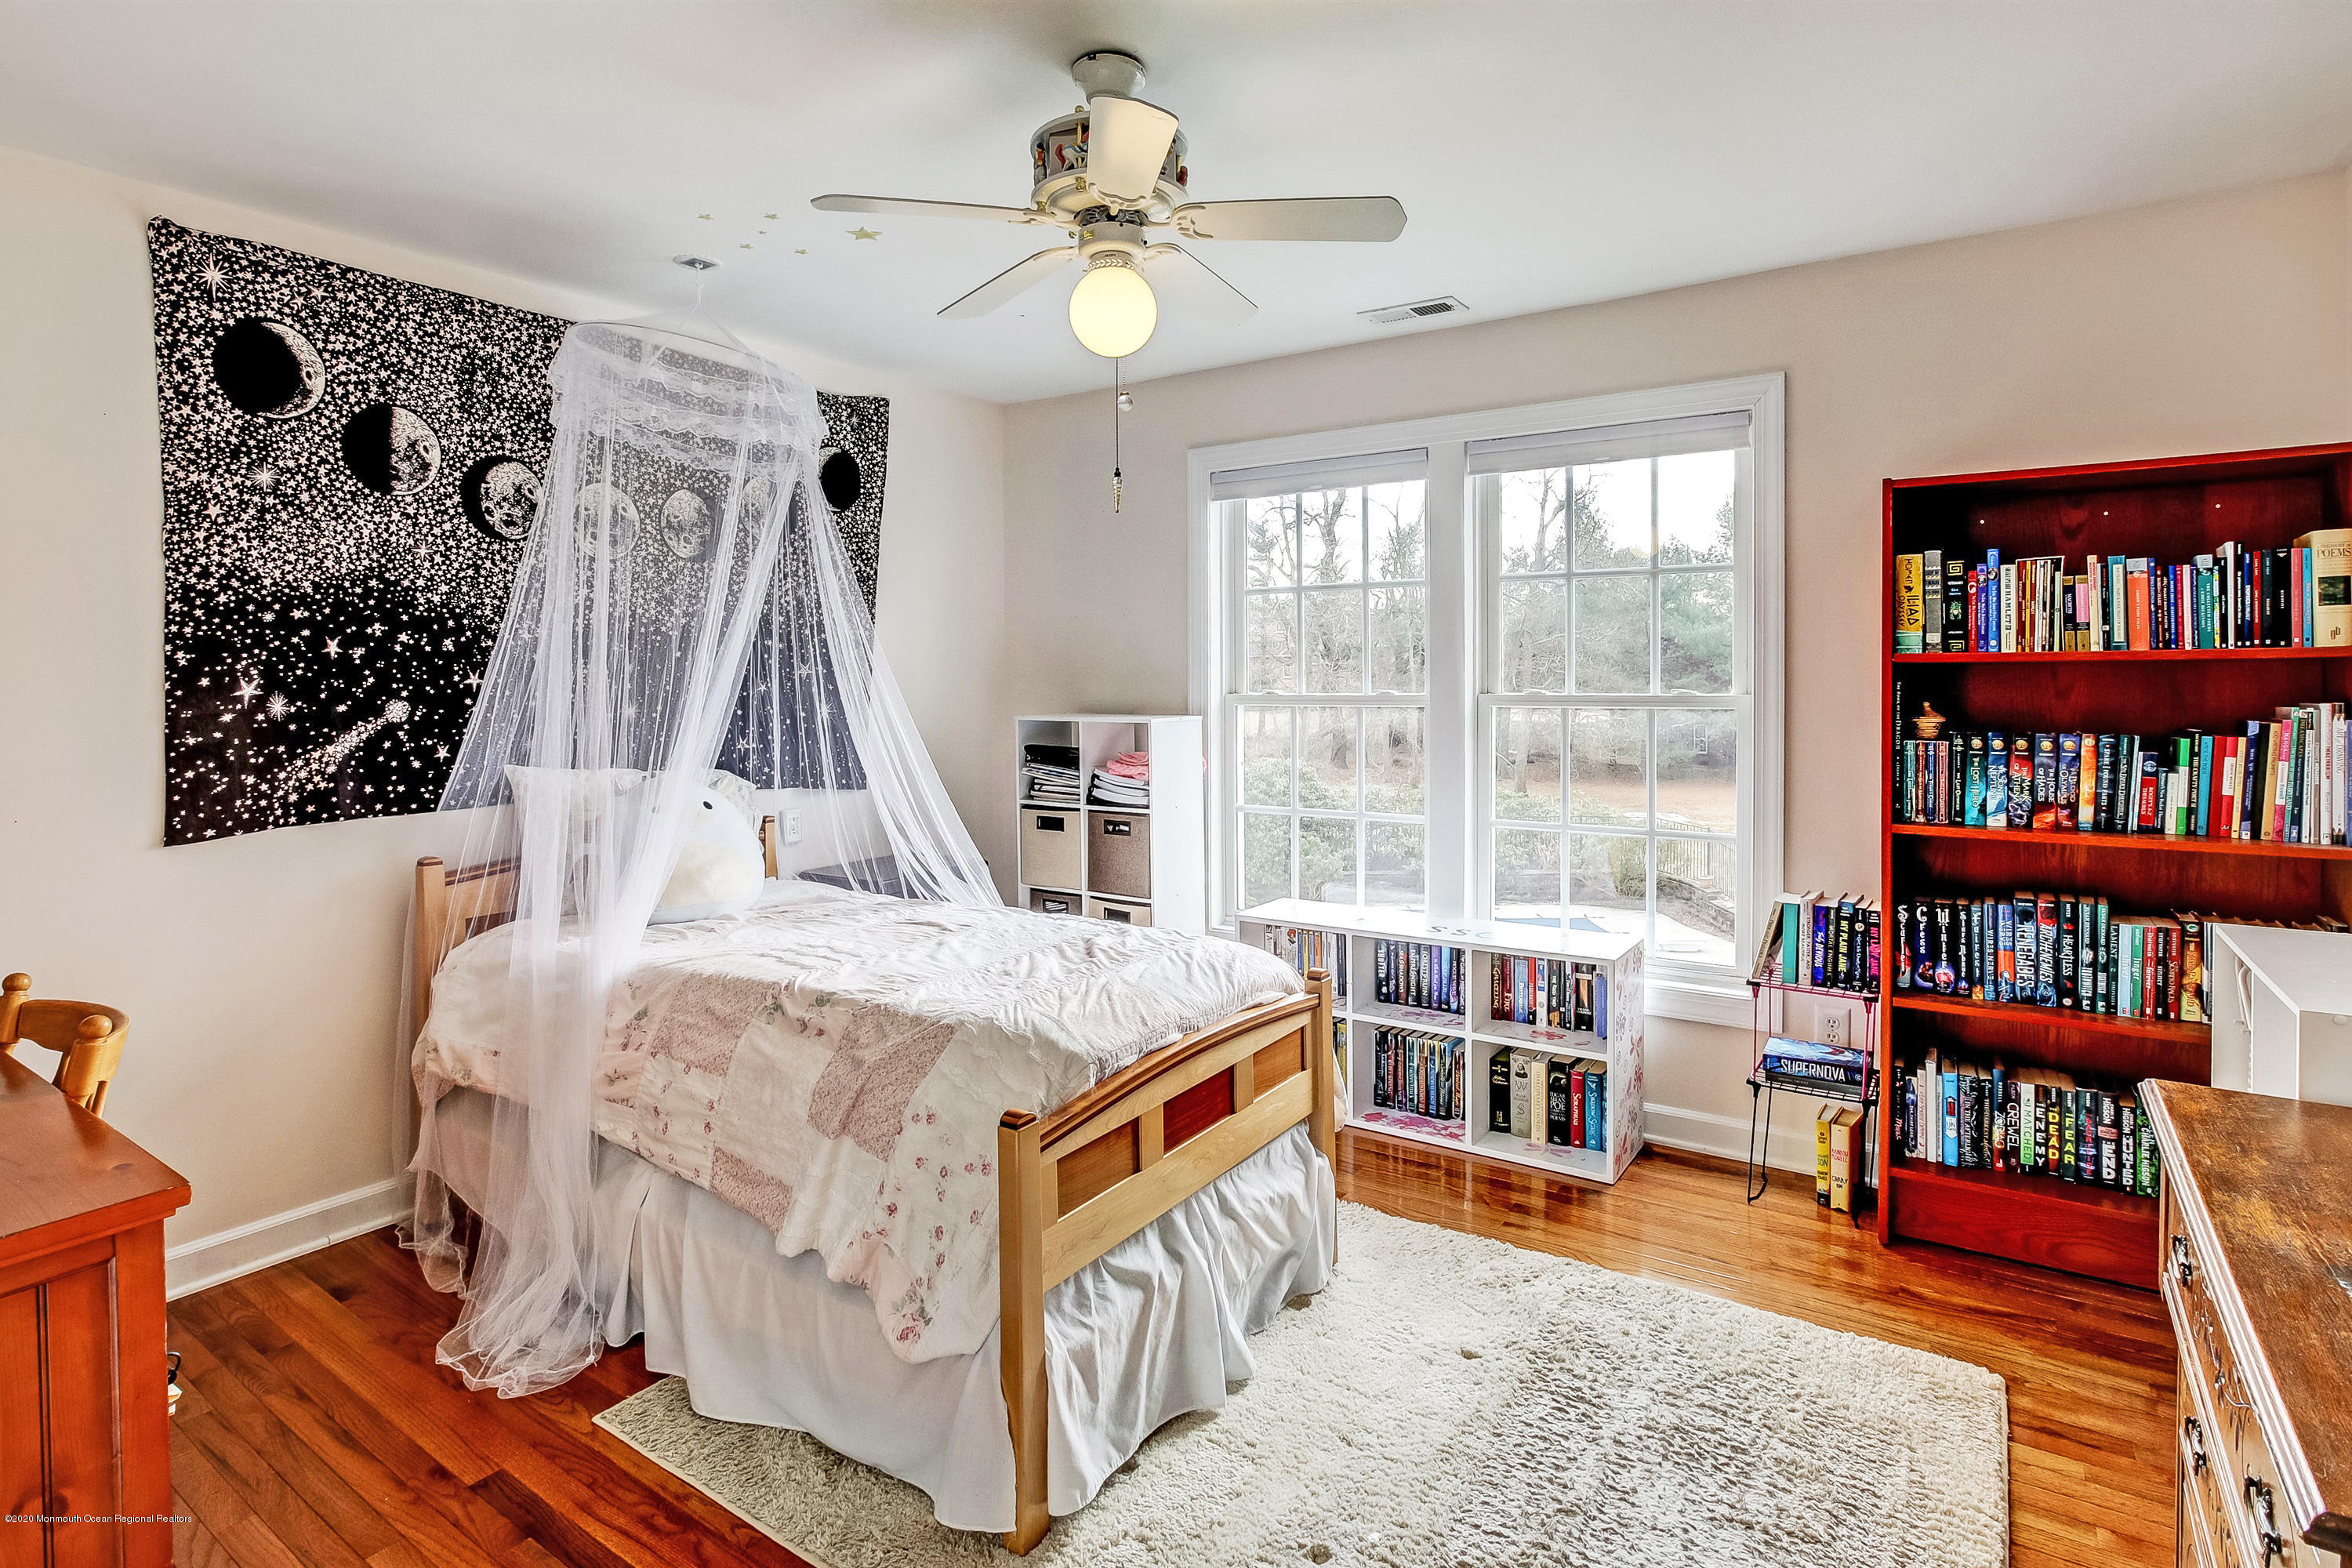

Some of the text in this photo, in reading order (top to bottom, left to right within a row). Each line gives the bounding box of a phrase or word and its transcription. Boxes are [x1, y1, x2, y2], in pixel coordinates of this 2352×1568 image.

[2317, 548, 2351, 558] POEMS
[1906, 595, 1920, 626] ILIAD
[2281, 732, 2290, 752] MANGA
[2298, 719, 2307, 757] DREAMSCAPES
[2335, 728, 2345, 775] ART DRAWING
[1971, 767, 1981, 786] LOST
[1987, 764, 1999, 800] NEPTUNE
[2011, 763, 2023, 804] OF ATHENA
[2021, 777, 2033, 802] MARK
[2036, 768, 2047, 802] OF HADES
[2046, 778, 2056, 803] HOUSE
[2059, 771, 2069, 805] OLYMPUS
[2068, 776, 2078, 803] BLOOD
[1969, 786, 1981, 808] HERO
[2285, 781, 2295, 810] FAIRYLAND
[1838, 920, 1849, 973] MY PLAIN JANE
[1897, 905, 1909, 972] Scarlet
[1915, 906, 1928, 954] Cress
[1935, 908, 1950, 970] Winter
[1972, 911, 1982, 978] Fairest
[2110, 925, 2118, 960] LAMENT
[1814, 942, 1824, 967] DEVIOUS
[1869, 927, 1880, 976] MY LADY JANE
[2016, 924, 2035, 988] RENEGADES
[2039, 922, 2055, 984] ARCHENEMIES
[2059, 934, 2075, 977] HEARTLESS
[2122, 953, 2132, 980] shiver
[2132, 957, 2142, 981] linger
[2146, 966, 2154, 989] forever
[1503, 992, 1512, 1012] FIRE
[1780, 1058, 1846, 1083] SUPERNOVA
[1549, 1102, 1566, 1111] POE
[1588, 1091, 1598, 1116] SHADOW
[2102, 1098, 2112, 1125] HIGSON
[2122, 1107, 2132, 1134] HIGSON
[1994, 1110, 2006, 1149] ZODIAC
[2006, 1102, 2020, 1151] CREWEL
[2023, 1109, 2032, 1160] MATCHED
[2034, 1107, 2046, 1167] ENEMY
[2048, 1112, 2060, 1160] DEAD
[2063, 1117, 2076, 1166] FEAR
[1817, 1158, 1829, 1167] SON
[2085, 1117, 2093, 1175] SACRIFICE
[2101, 1144, 2116, 1180] END
[2122, 1137, 2134, 1185] HUNTED
[2140, 1127, 2151, 1186] CHARLIE HIGSON
[1831, 1175, 1849, 1185] CARRY
